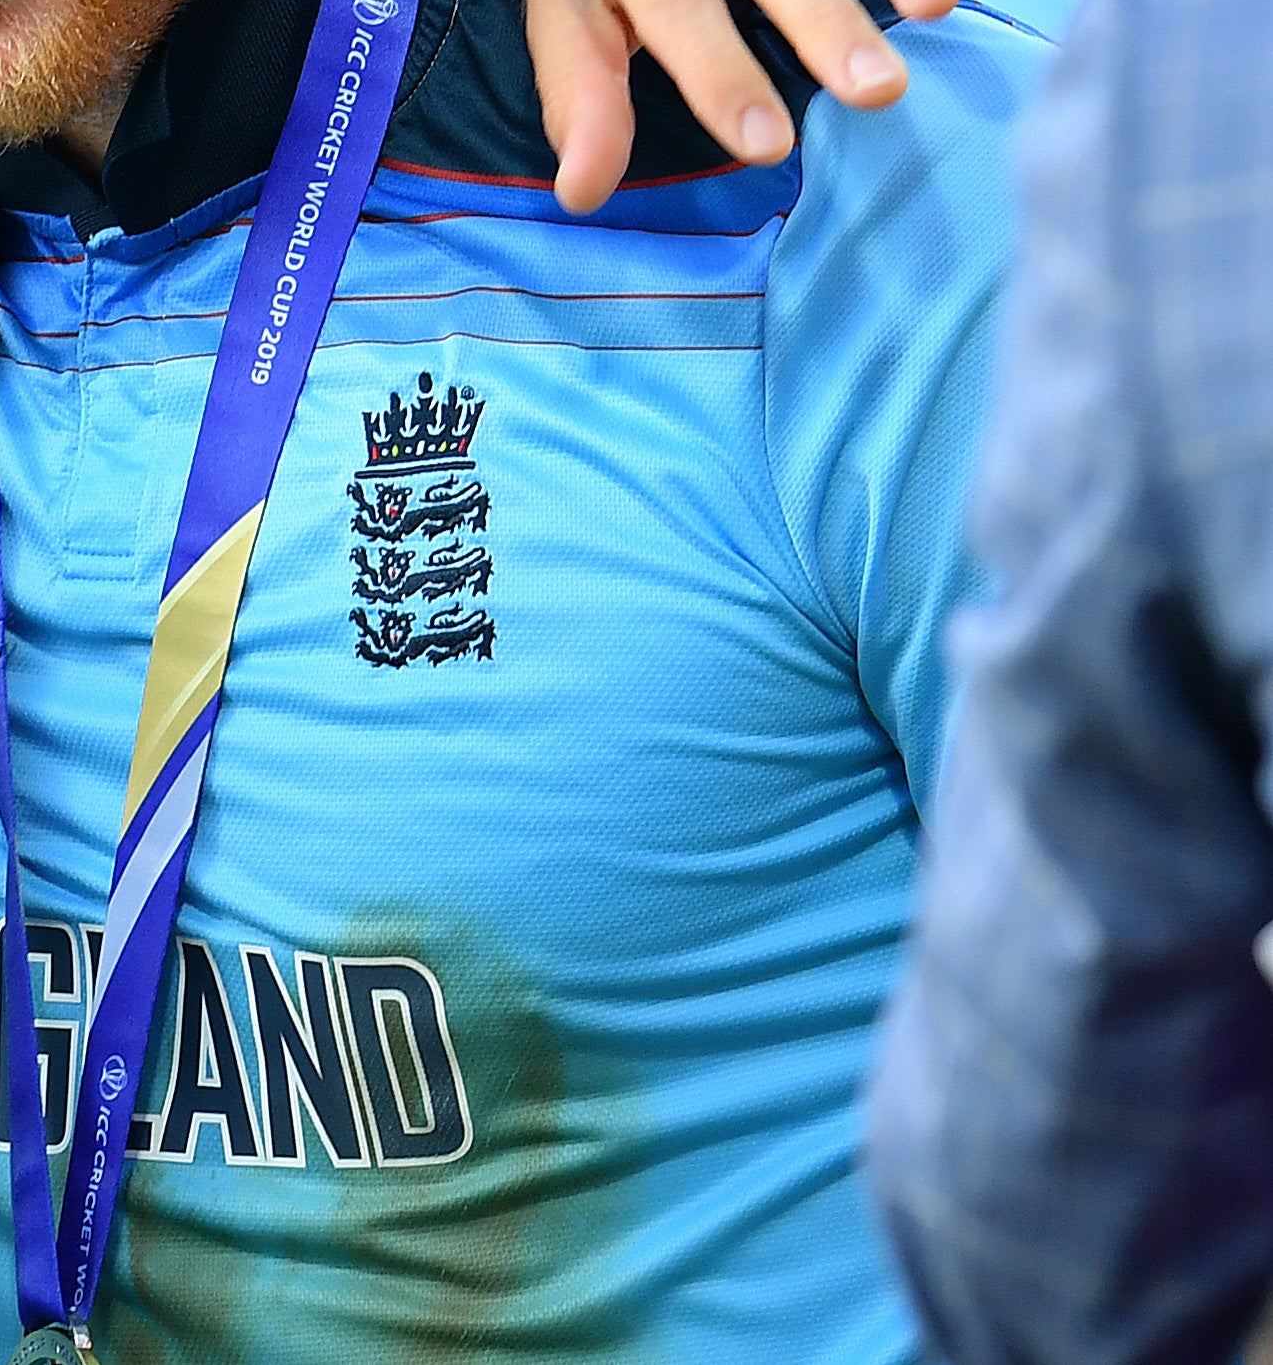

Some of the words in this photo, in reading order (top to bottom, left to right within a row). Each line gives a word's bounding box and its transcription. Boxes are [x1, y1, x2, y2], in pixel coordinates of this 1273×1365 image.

[346, 27, 374, 70] ICC
[314, 71, 361, 177] CRICKET
[284, 180, 330, 272] WORLD
[268, 275, 298, 328] CUP
[250, 327, 282, 385] 2019
[95, 1105, 111, 1147] ICC
[79, 1149, 106, 1257] CRICKET
